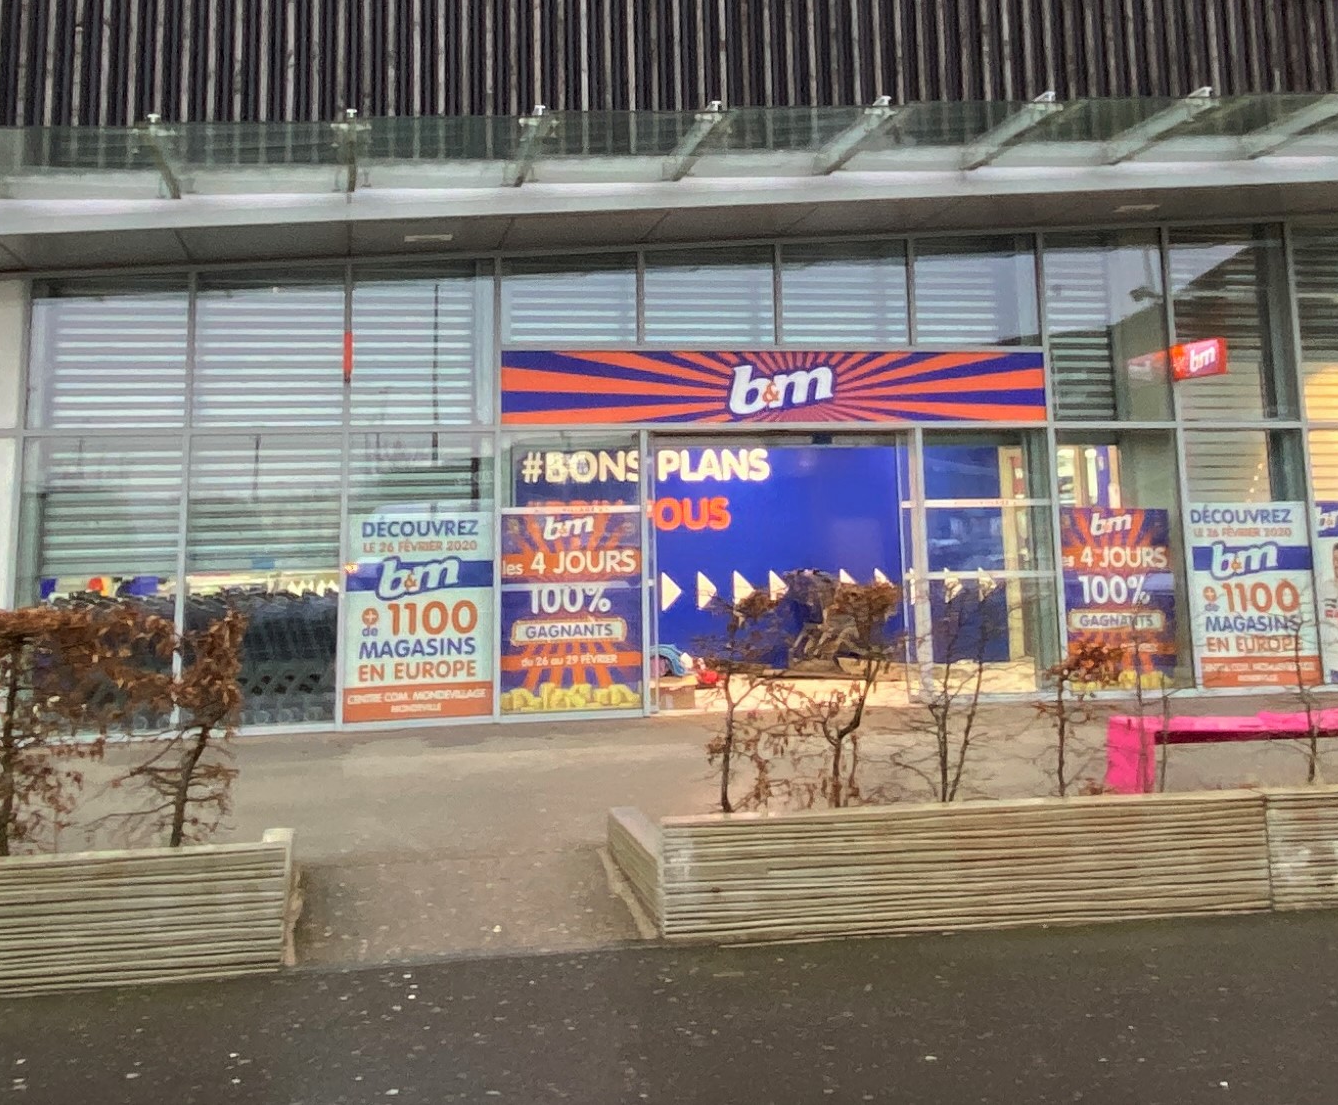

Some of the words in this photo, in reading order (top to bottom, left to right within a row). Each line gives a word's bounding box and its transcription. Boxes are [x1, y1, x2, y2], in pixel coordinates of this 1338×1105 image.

[728, 364, 833, 415] b&m
[521, 450, 639, 484] #BONS
[657, 449, 771, 481] PLANS
[1190, 504, 1293, 524] DÉCOUVREZ
[362, 515, 478, 537] DÉCOUVREZ
[544, 516, 594, 540] b&m
[447, 540, 478, 551] 2020
[503, 561, 524, 575] les
[530, 552, 547, 574] 4
[553, 550, 637, 574] JOURS
[1062, 556, 1074, 567] es
[1080, 546, 1094, 567] 4
[1099, 546, 1168, 568] JOURS
[1211, 541, 1279, 579] b&m
[378, 556, 460, 600] b&m
[1078, 574, 1150, 604] 100%
[530, 587, 611, 614] 100%
[1222, 579, 1300, 613] 1100
[362, 627, 378, 637] de
[388, 600, 478, 636] 1100
[1079, 615, 1154, 627] GAGNANTS
[1206, 615, 1302, 633] MAGASINS
[526, 623, 613, 638] GAGNANTS
[359, 637, 476, 659] MAGASINS
[1206, 637, 1229, 652] EN
[1236, 635, 1302, 652] EUROPE
[358, 663, 384, 682] EN
[394, 660, 477, 679] EUROPE
[536, 656, 548, 666] 26
